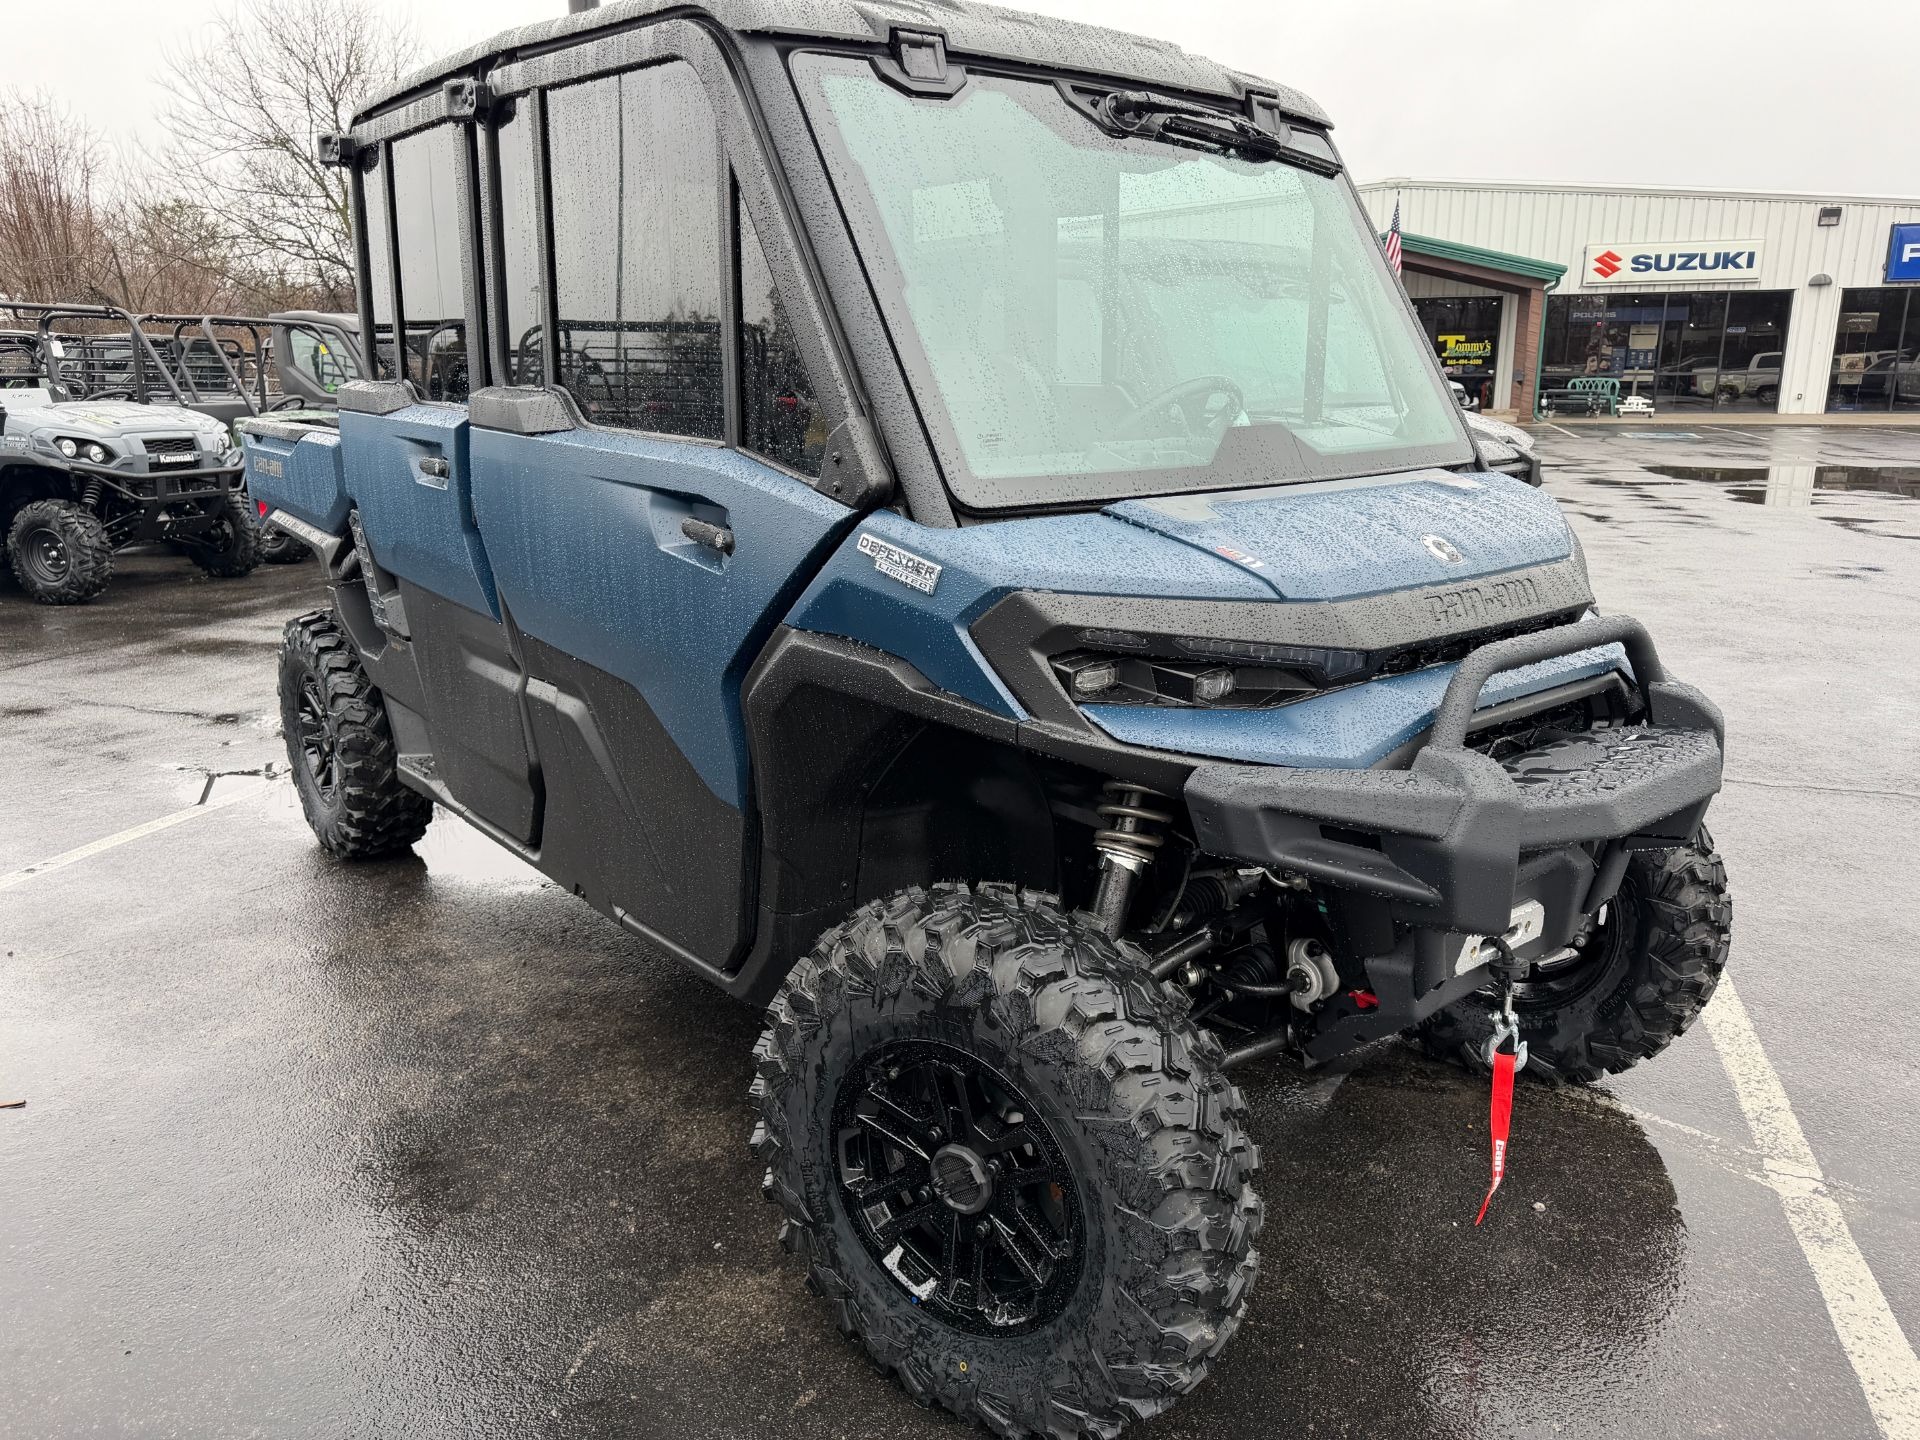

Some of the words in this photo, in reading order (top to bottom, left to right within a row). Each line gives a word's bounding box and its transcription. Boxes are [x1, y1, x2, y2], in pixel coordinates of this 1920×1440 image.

[1630, 250, 1756, 273] SUZUKI
[1437, 335, 1492, 357] Tommy's
[159, 453, 195, 464] Kawasaki
[859, 536, 937, 578] DEFENDER
